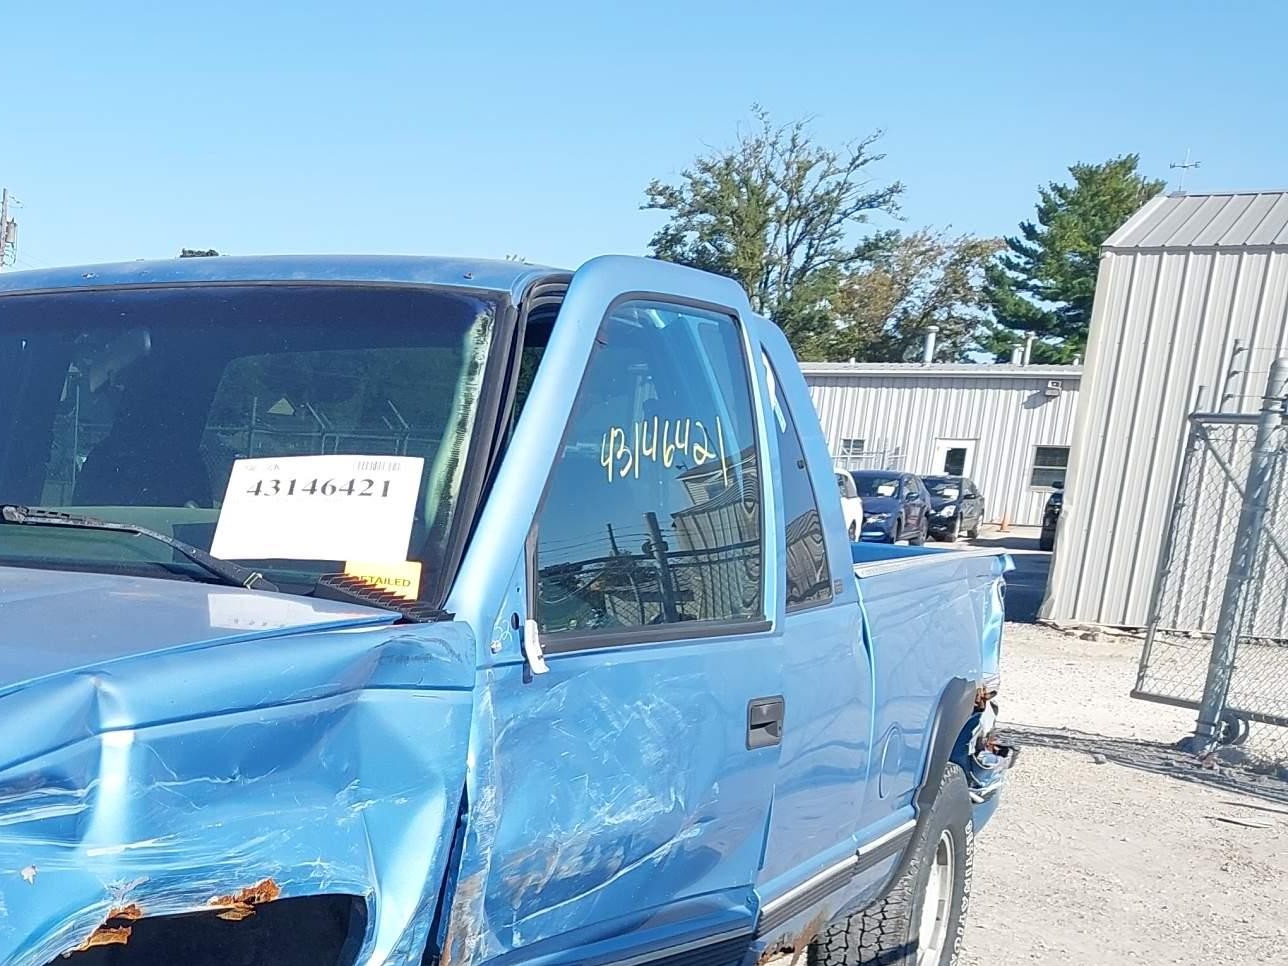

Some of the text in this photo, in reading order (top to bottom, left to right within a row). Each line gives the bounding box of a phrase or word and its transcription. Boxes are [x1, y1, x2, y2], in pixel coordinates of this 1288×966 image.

[600, 416, 729, 488] 43146421
[246, 477, 391, 498] 43146421
[354, 575, 412, 588] ETAILED
